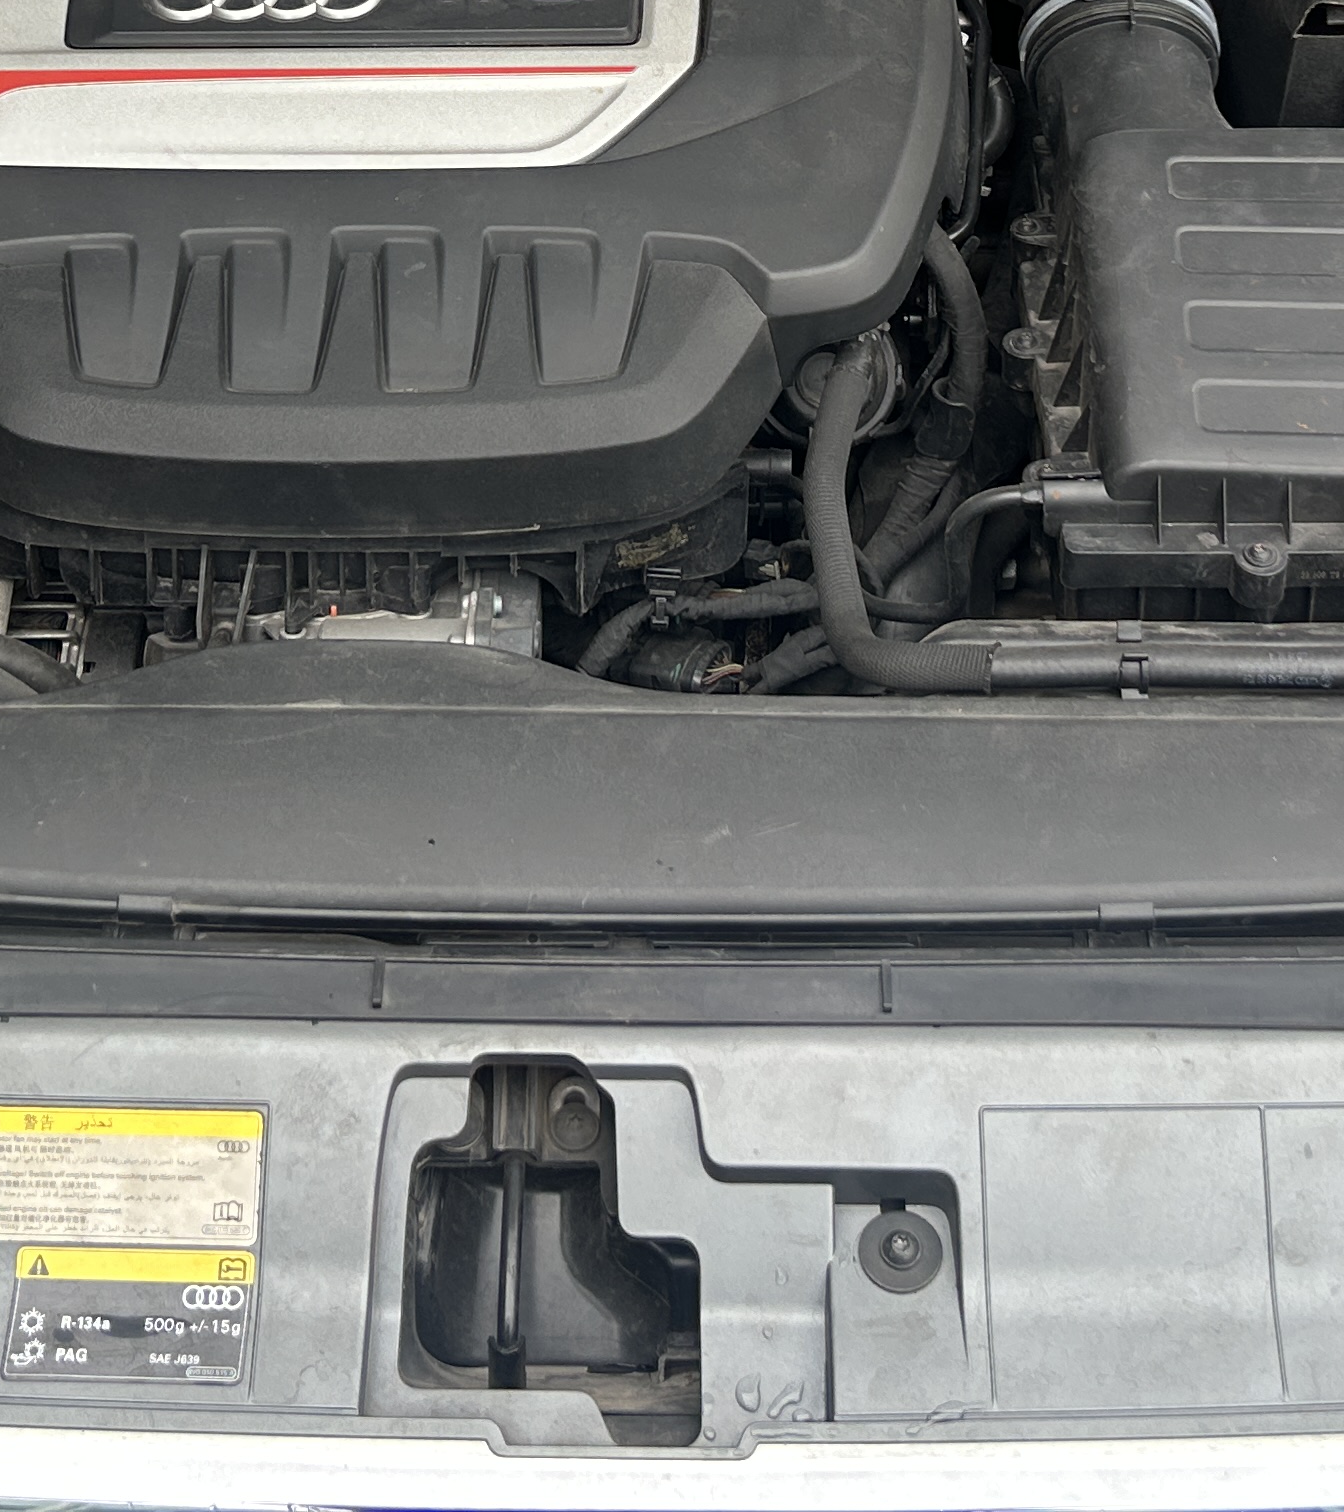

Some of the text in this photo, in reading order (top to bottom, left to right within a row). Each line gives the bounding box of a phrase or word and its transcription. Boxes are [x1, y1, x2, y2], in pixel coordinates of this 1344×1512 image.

[24, 1114, 54, 1131] 警告
[61, 1315, 111, 1331] R-134a
[144, 1317, 184, 1335] 500g
[56, 1347, 200, 1365] PAG SAE J639
